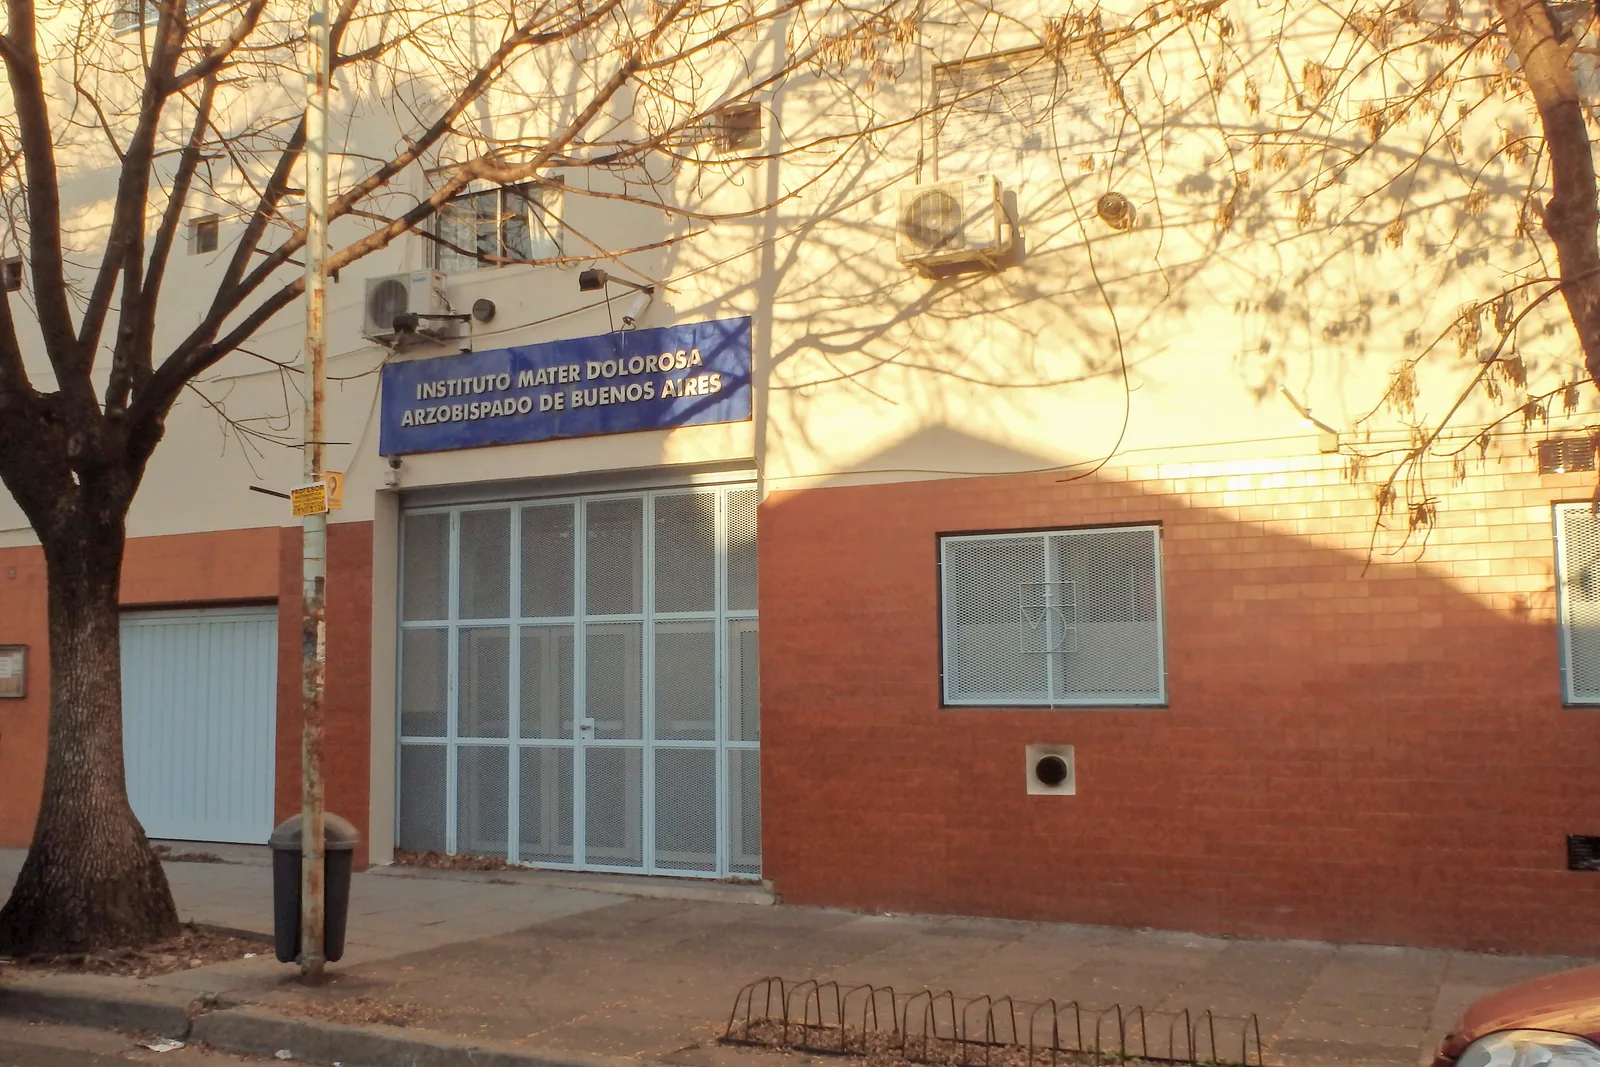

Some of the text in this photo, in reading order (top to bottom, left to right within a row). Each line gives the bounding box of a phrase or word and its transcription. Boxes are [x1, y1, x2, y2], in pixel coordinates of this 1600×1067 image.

[401, 374, 723, 427] ARZOBISPADO DE BUENOS AIRES
[416, 349, 702, 401] INSTITUTO MATER DOLOROSA
